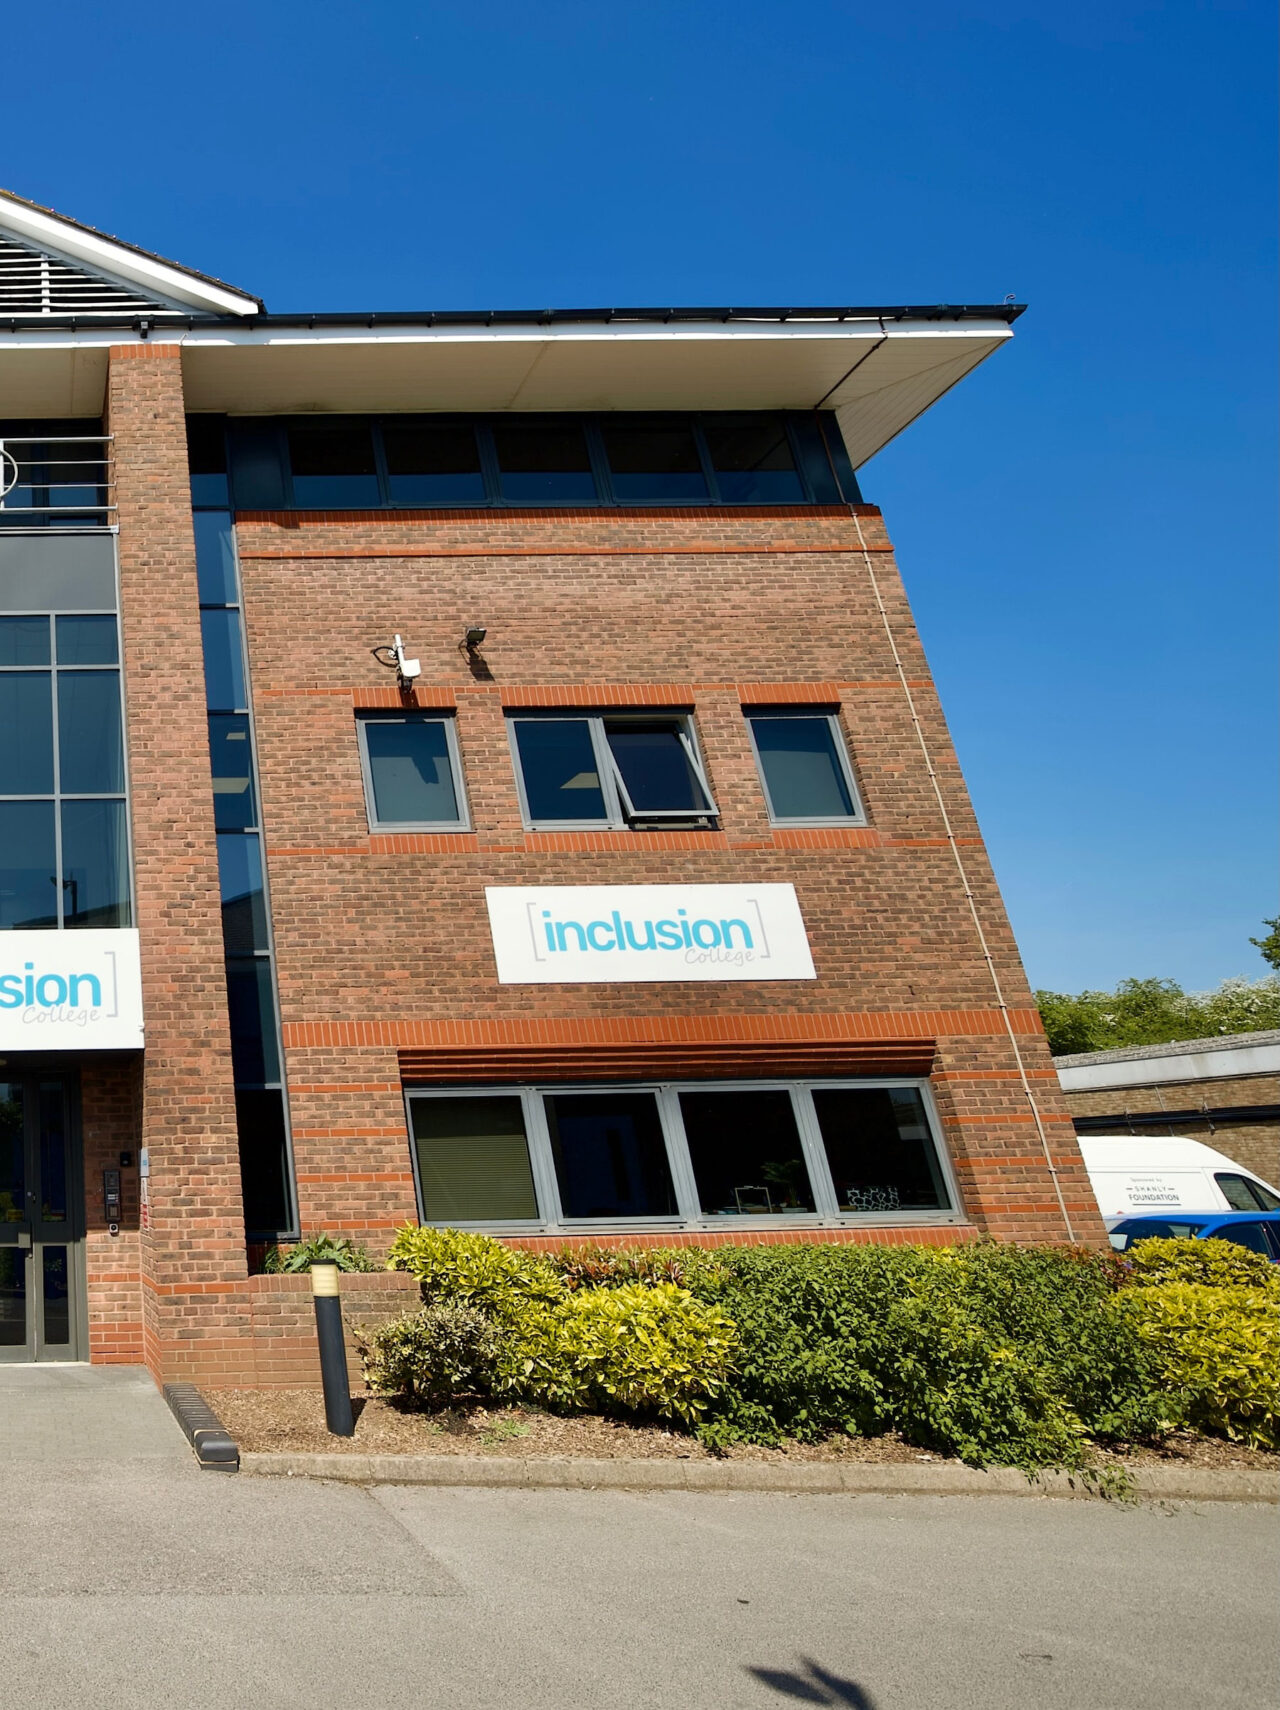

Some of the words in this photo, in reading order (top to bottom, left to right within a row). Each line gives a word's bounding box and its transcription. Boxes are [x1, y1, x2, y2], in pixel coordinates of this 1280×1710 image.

[542, 909, 754, 952] inclusion
[684, 949, 755, 967] College
[22, 1006, 100, 1027] College
